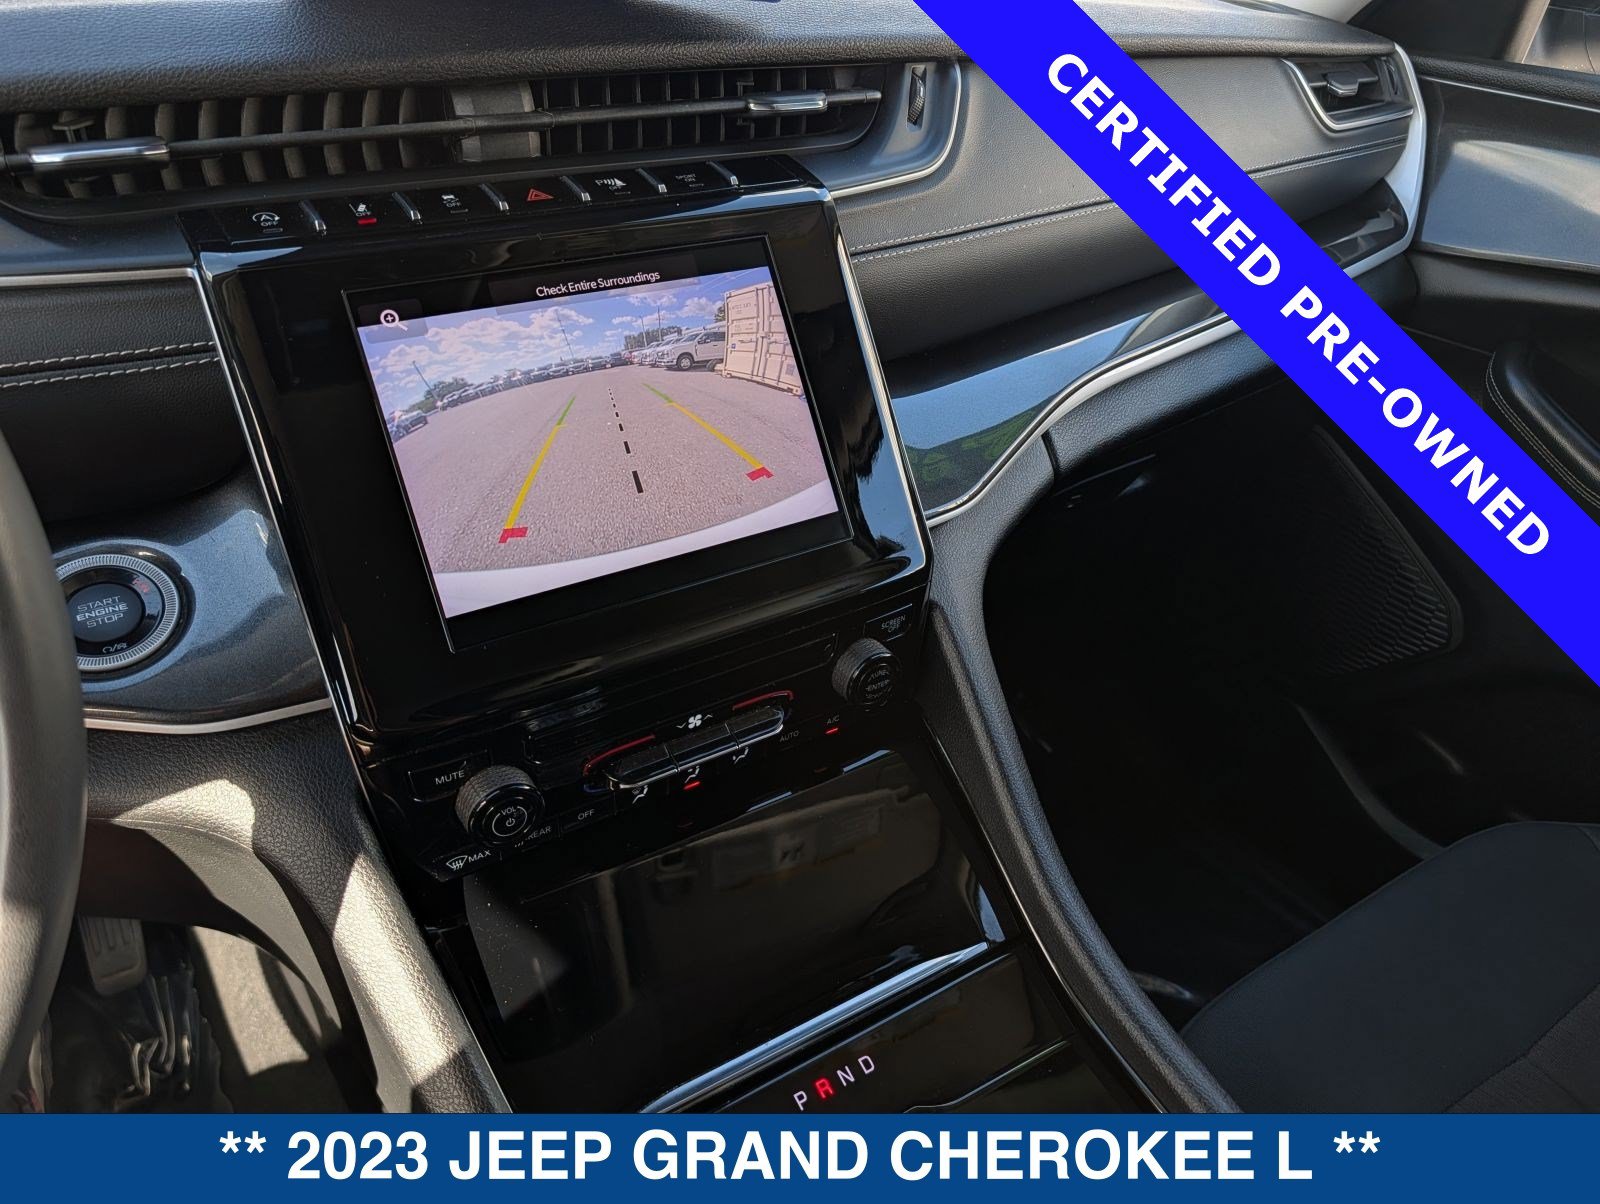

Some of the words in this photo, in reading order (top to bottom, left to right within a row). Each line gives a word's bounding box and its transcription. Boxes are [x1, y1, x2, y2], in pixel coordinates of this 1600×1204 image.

[260, 219, 279, 227] OFF
[536, 283, 569, 297] Check
[568, 280, 597, 292] Entire
[598, 272, 660, 288] Surroundings
[78, 595, 121, 612] START
[76, 602, 128, 622] ENGINE
[86, 612, 124, 628] STOP
[881, 615, 906, 630] SCREEN
[826, 714, 840, 725] A/C
[779, 730, 800, 743] AUTO
[435, 769, 465, 785] MUTE
[500, 806, 517, 816] VOL
[577, 808, 596, 821] OFF
[468, 850, 492, 863] MAX
[793, 1090, 808, 1111] P
[815, 1078, 834, 1099] R
[836, 1065, 855, 1087] N
[857, 1055, 875, 1075] D
